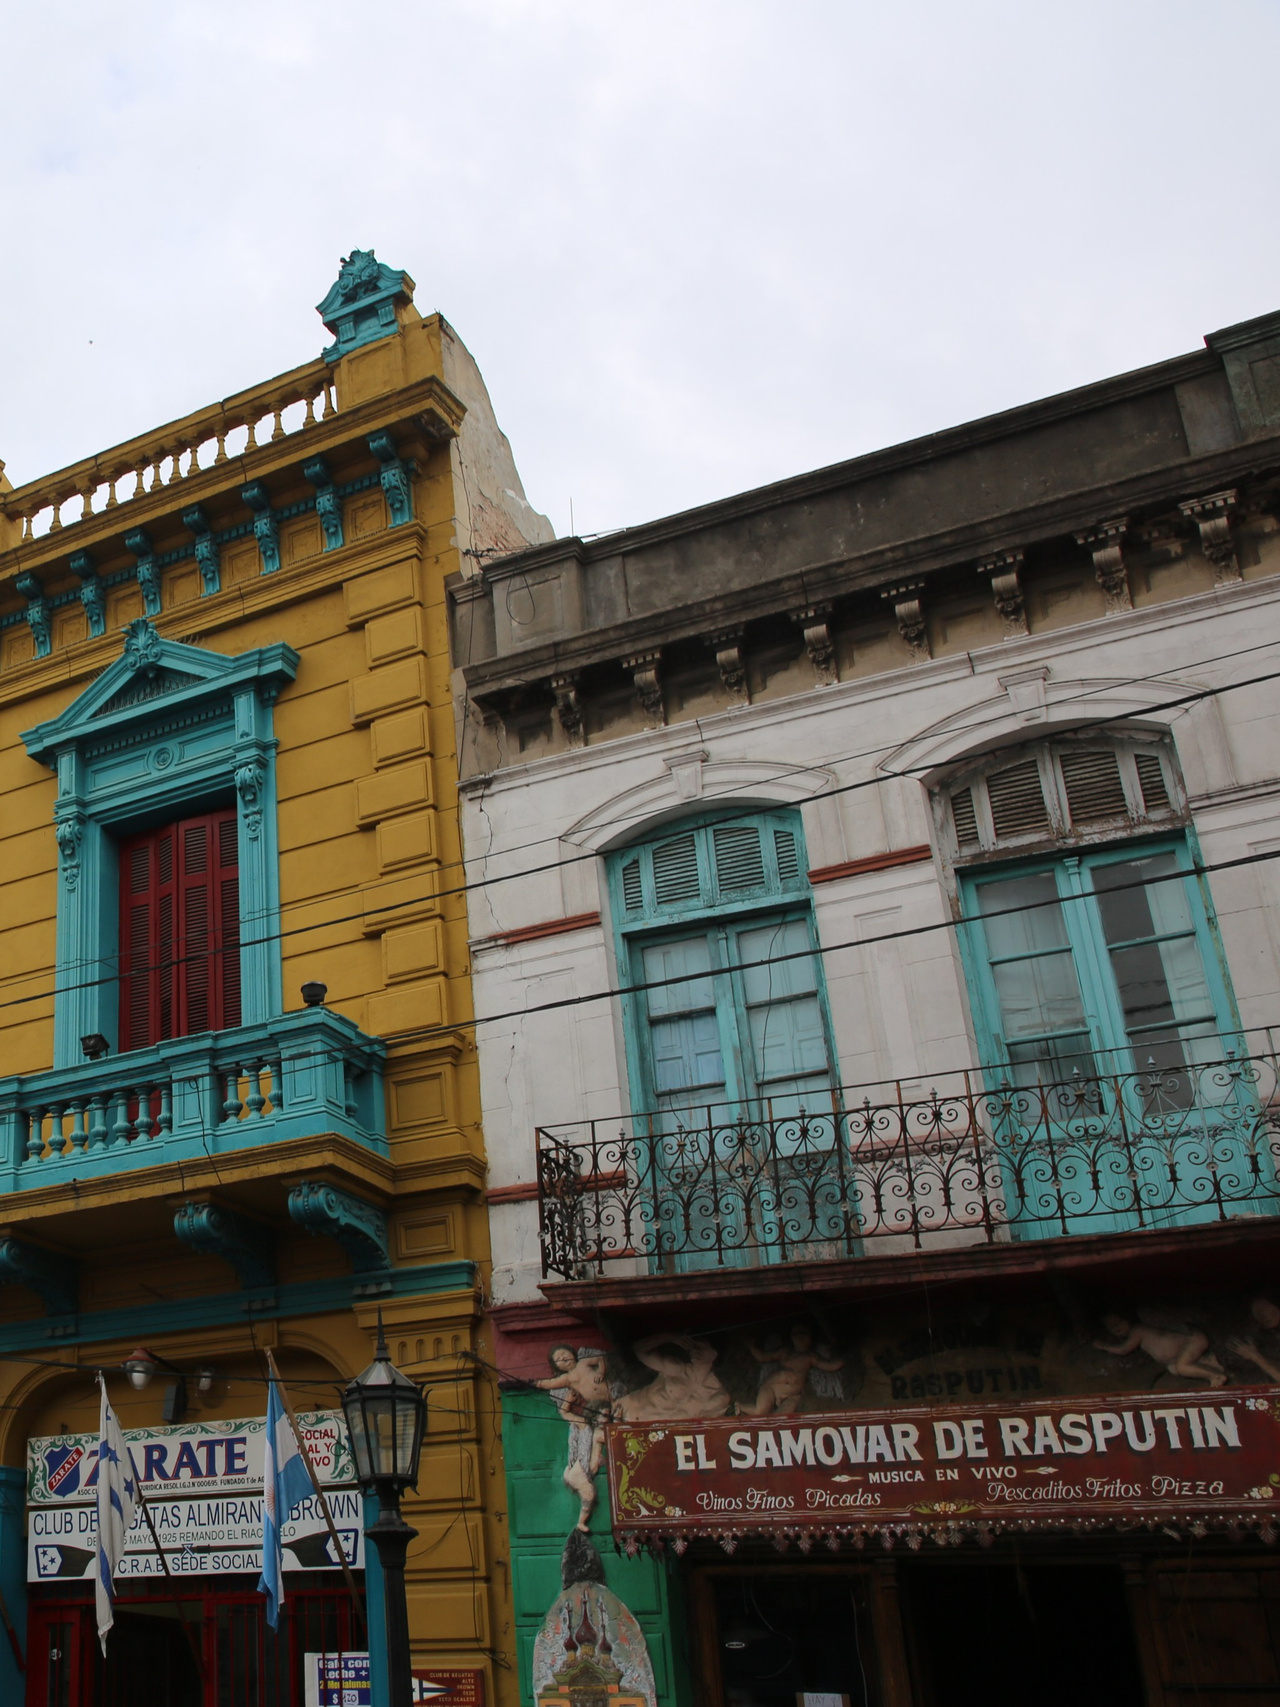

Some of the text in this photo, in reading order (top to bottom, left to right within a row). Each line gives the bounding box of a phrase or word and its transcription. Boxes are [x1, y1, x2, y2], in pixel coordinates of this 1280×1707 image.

[890, 1365, 1043, 1400] RASPUTIN
[674, 1407, 1243, 1471] EL SAMOVAR DE RASPUTIN
[50, 1451, 80, 1486] ZARATE
[84, 1437, 249, 1487] ZRATE
[220, 1478, 246, 1486] FUNDADO
[868, 1466, 1018, 1484] MUSICA EN VIVO
[987, 1475, 1225, 1501] Pescaditos Fritos Pizza
[696, 1487, 882, 1511] Vinos Finos Picadas
[33, 1512, 74, 1536] CLUB
[78, 1510, 98, 1533] DE
[185, 1499, 265, 1528] ALMIRAN
[290, 1494, 359, 1521] BROWN
[129, 1533, 154, 1545] MAYO
[157, 1532, 178, 1543] 1925
[179, 1530, 225, 1542] REMANDO
[227, 1529, 239, 1540] EL
[172, 1555, 208, 1572] SEDE
[212, 1553, 263, 1570] SOCIAL
[347, 1659, 370, 1668] con
[319, 1680, 325, 1689] 2
[332, 1692, 339, 1705] $
